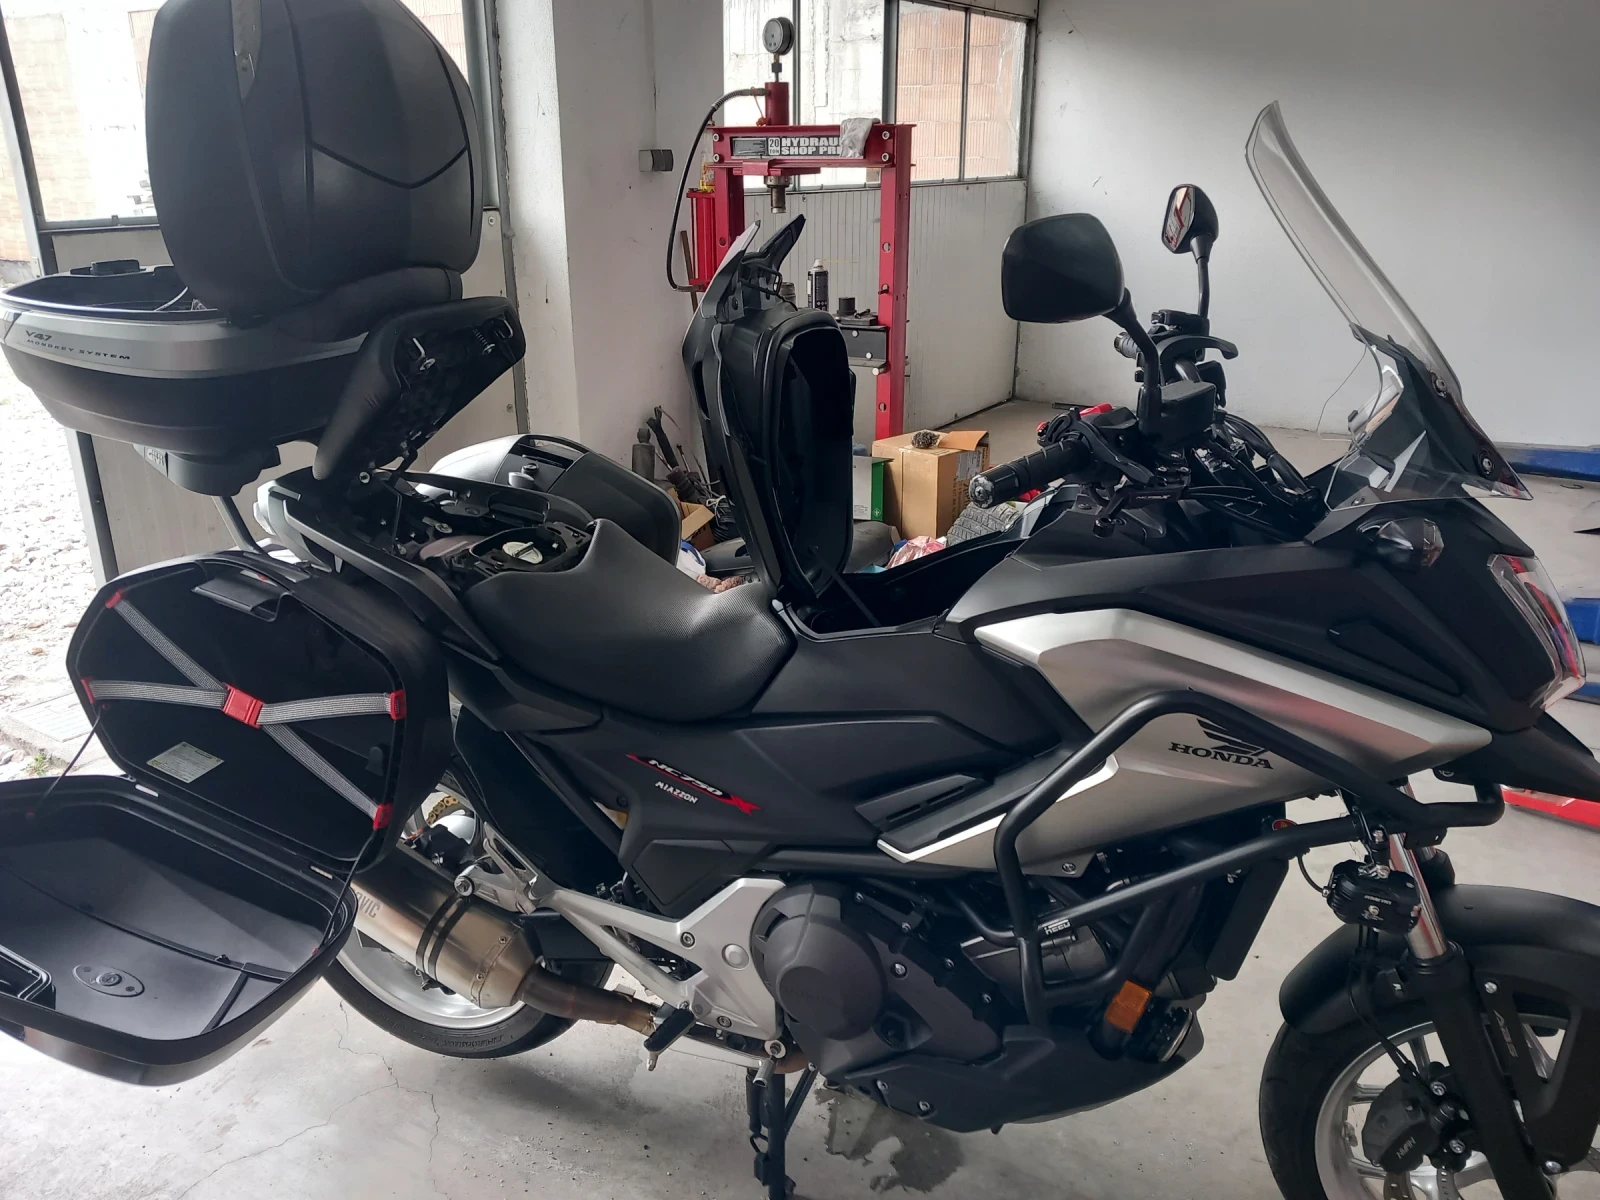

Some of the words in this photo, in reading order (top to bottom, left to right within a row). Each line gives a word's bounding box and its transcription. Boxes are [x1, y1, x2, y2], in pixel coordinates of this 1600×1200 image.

[769, 138, 780, 148] 20
[781, 137, 841, 147] HYDRAU
[781, 146, 817, 155] SHOP
[25, 330, 52, 341] V47
[27, 339, 75, 352] MONOKEY
[79, 349, 131, 360] SYSTEM
[1168, 741, 1274, 769] HONDA
